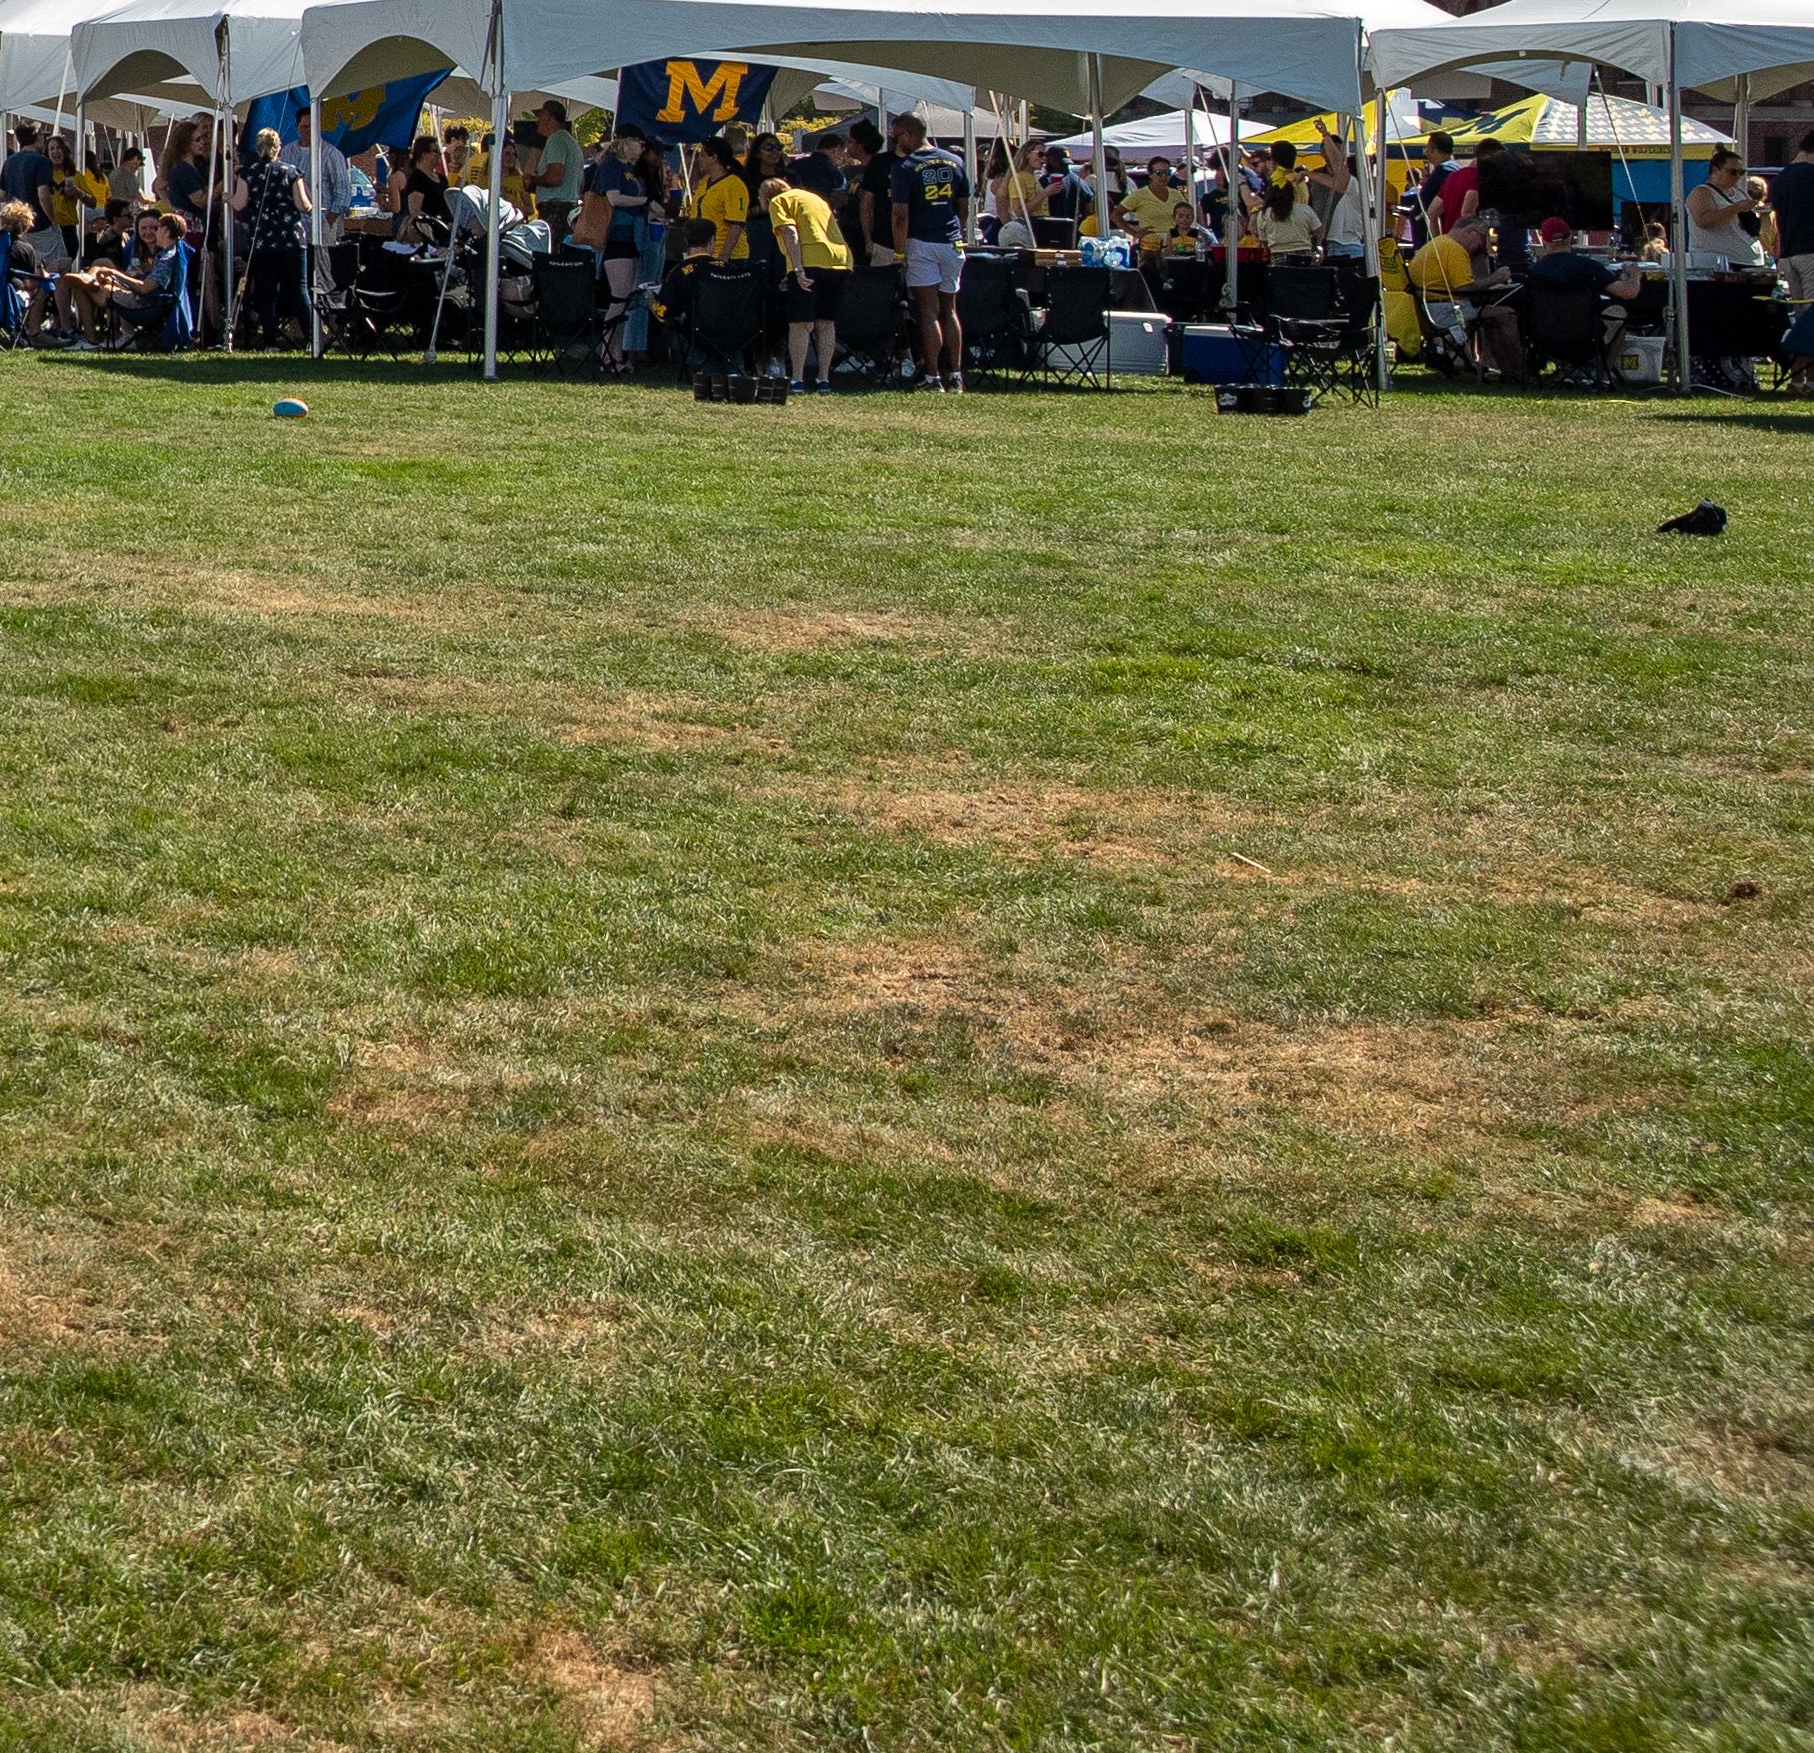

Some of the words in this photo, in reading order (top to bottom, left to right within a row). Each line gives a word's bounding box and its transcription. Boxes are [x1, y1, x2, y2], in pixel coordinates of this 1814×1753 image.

[655, 60, 749, 123] M
[921, 167, 954, 185] 20
[924, 183, 953, 200] 24
